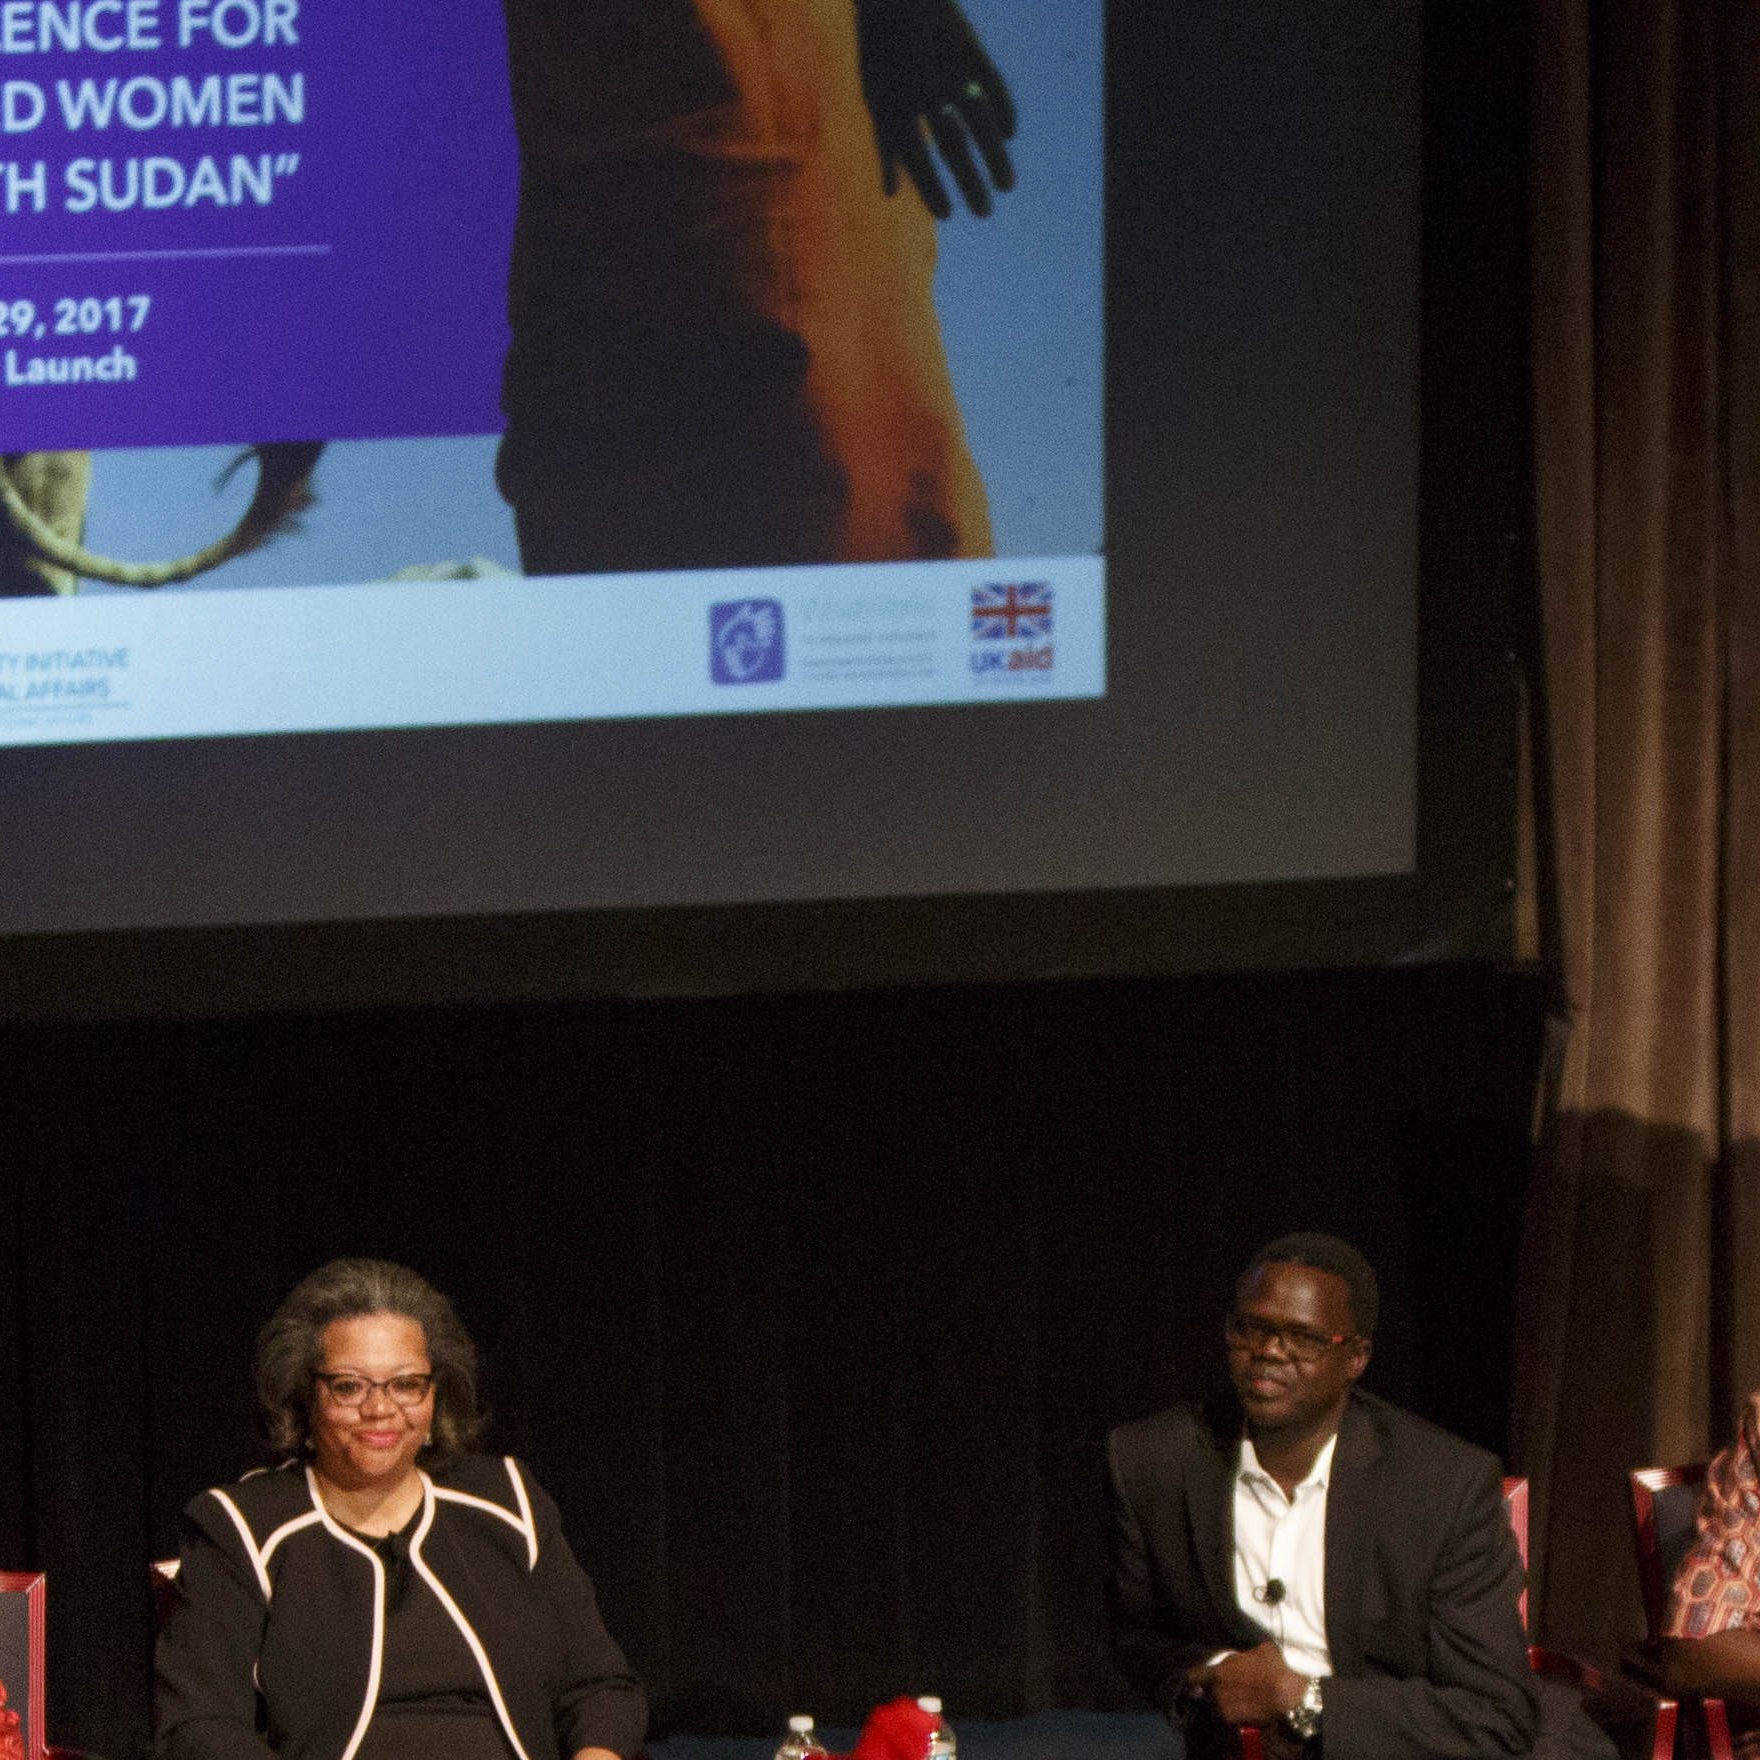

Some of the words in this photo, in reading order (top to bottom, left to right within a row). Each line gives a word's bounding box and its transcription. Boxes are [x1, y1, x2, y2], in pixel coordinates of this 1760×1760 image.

[178, 0, 300, 49] FOR
[57, 72, 304, 131] WOMEN
[54, 296, 152, 334] 2017
[5, 346, 137, 387] Launch
[25, 647, 129, 671] INITIATIVE
[25, 677, 111, 700] AFFAIRS
